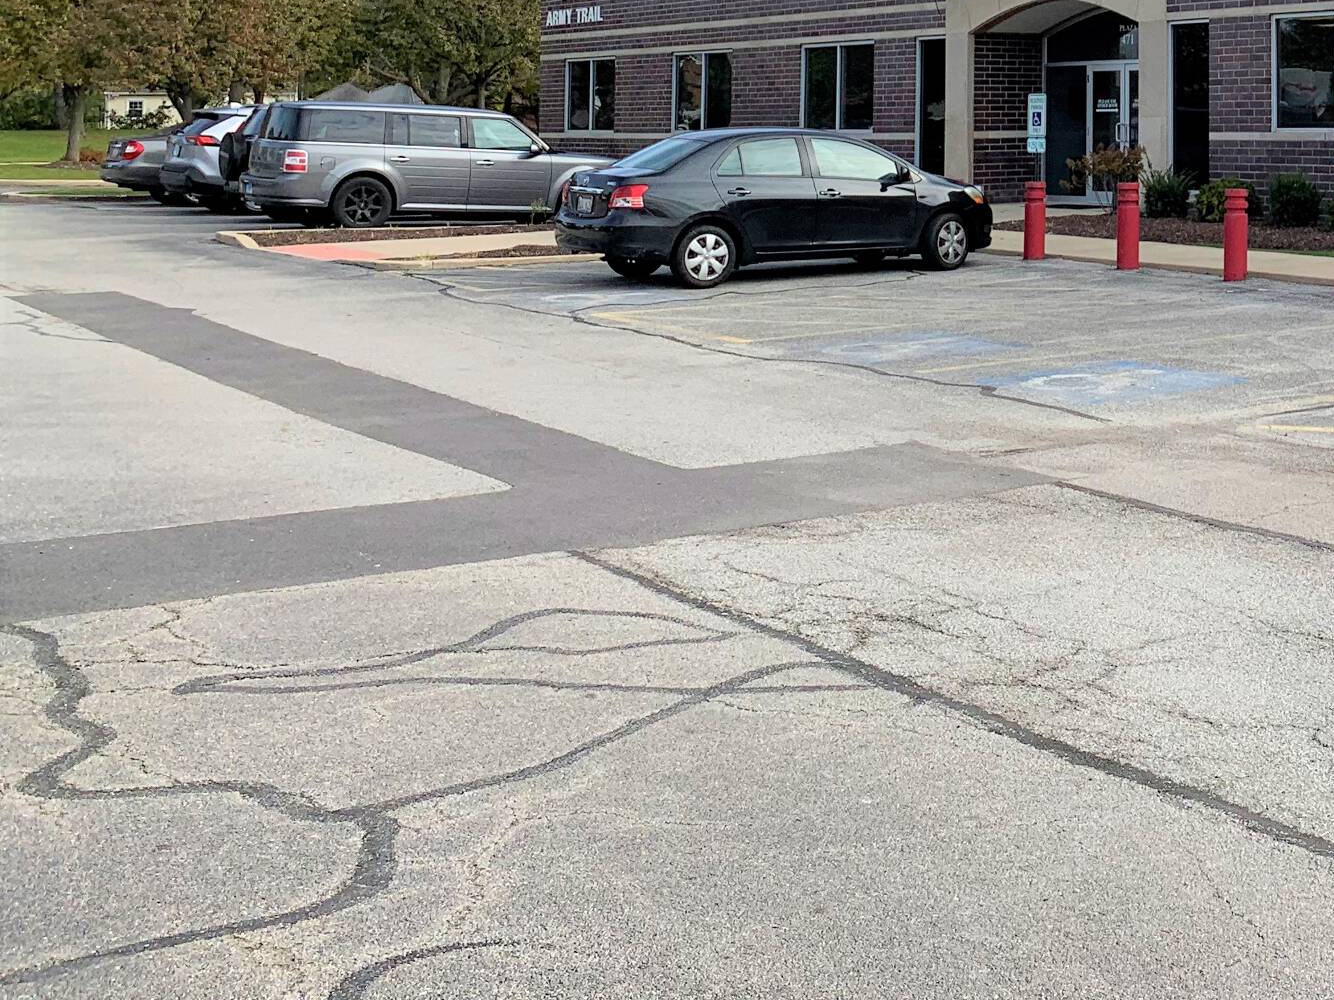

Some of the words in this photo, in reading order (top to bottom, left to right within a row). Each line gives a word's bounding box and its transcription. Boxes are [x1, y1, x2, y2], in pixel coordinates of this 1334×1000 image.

[546, 9, 572, 27] ARMY
[576, 6, 603, 24] TRAIL
[1121, 34, 1134, 45] 471
